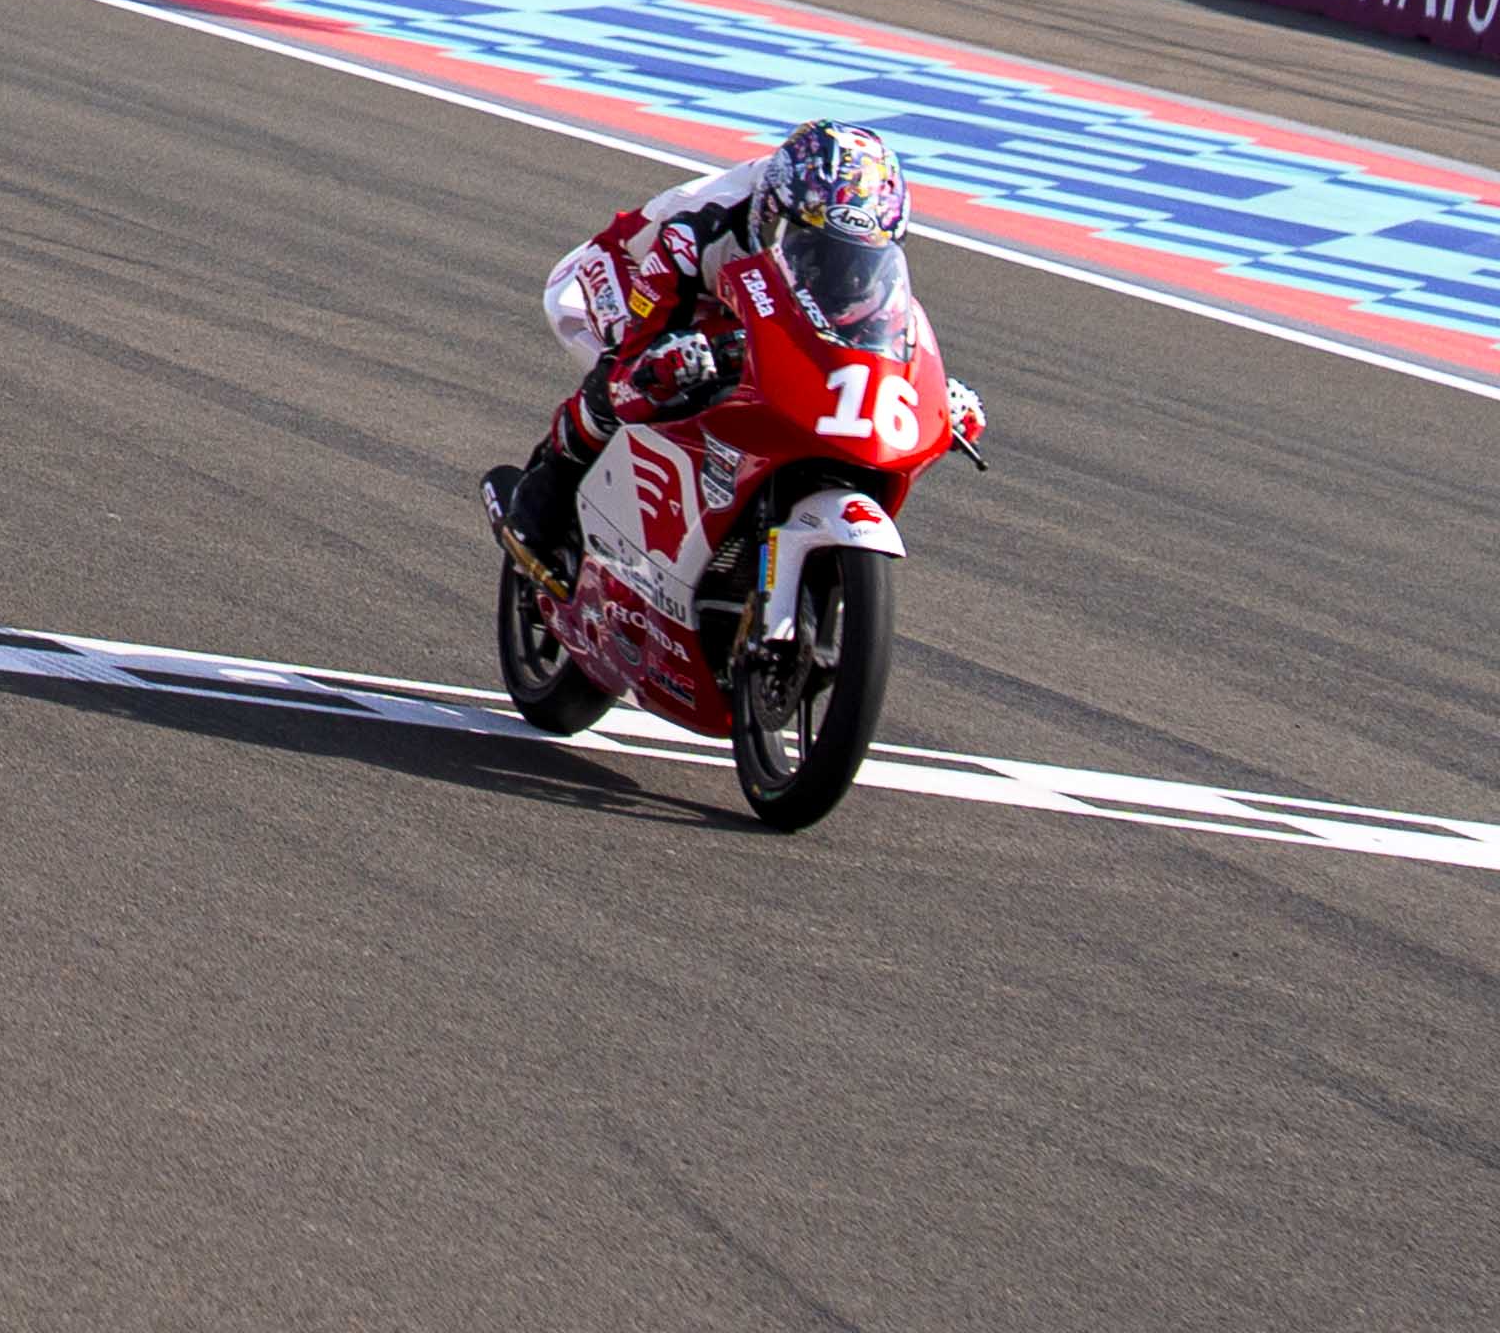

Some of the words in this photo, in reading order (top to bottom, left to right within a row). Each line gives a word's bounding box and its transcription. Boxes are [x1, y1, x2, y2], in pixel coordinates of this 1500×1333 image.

[835, 208, 870, 229] Arai
[746, 276, 775, 318] Beta
[815, 363, 920, 451] 16
[612, 604, 691, 663] HONDA
